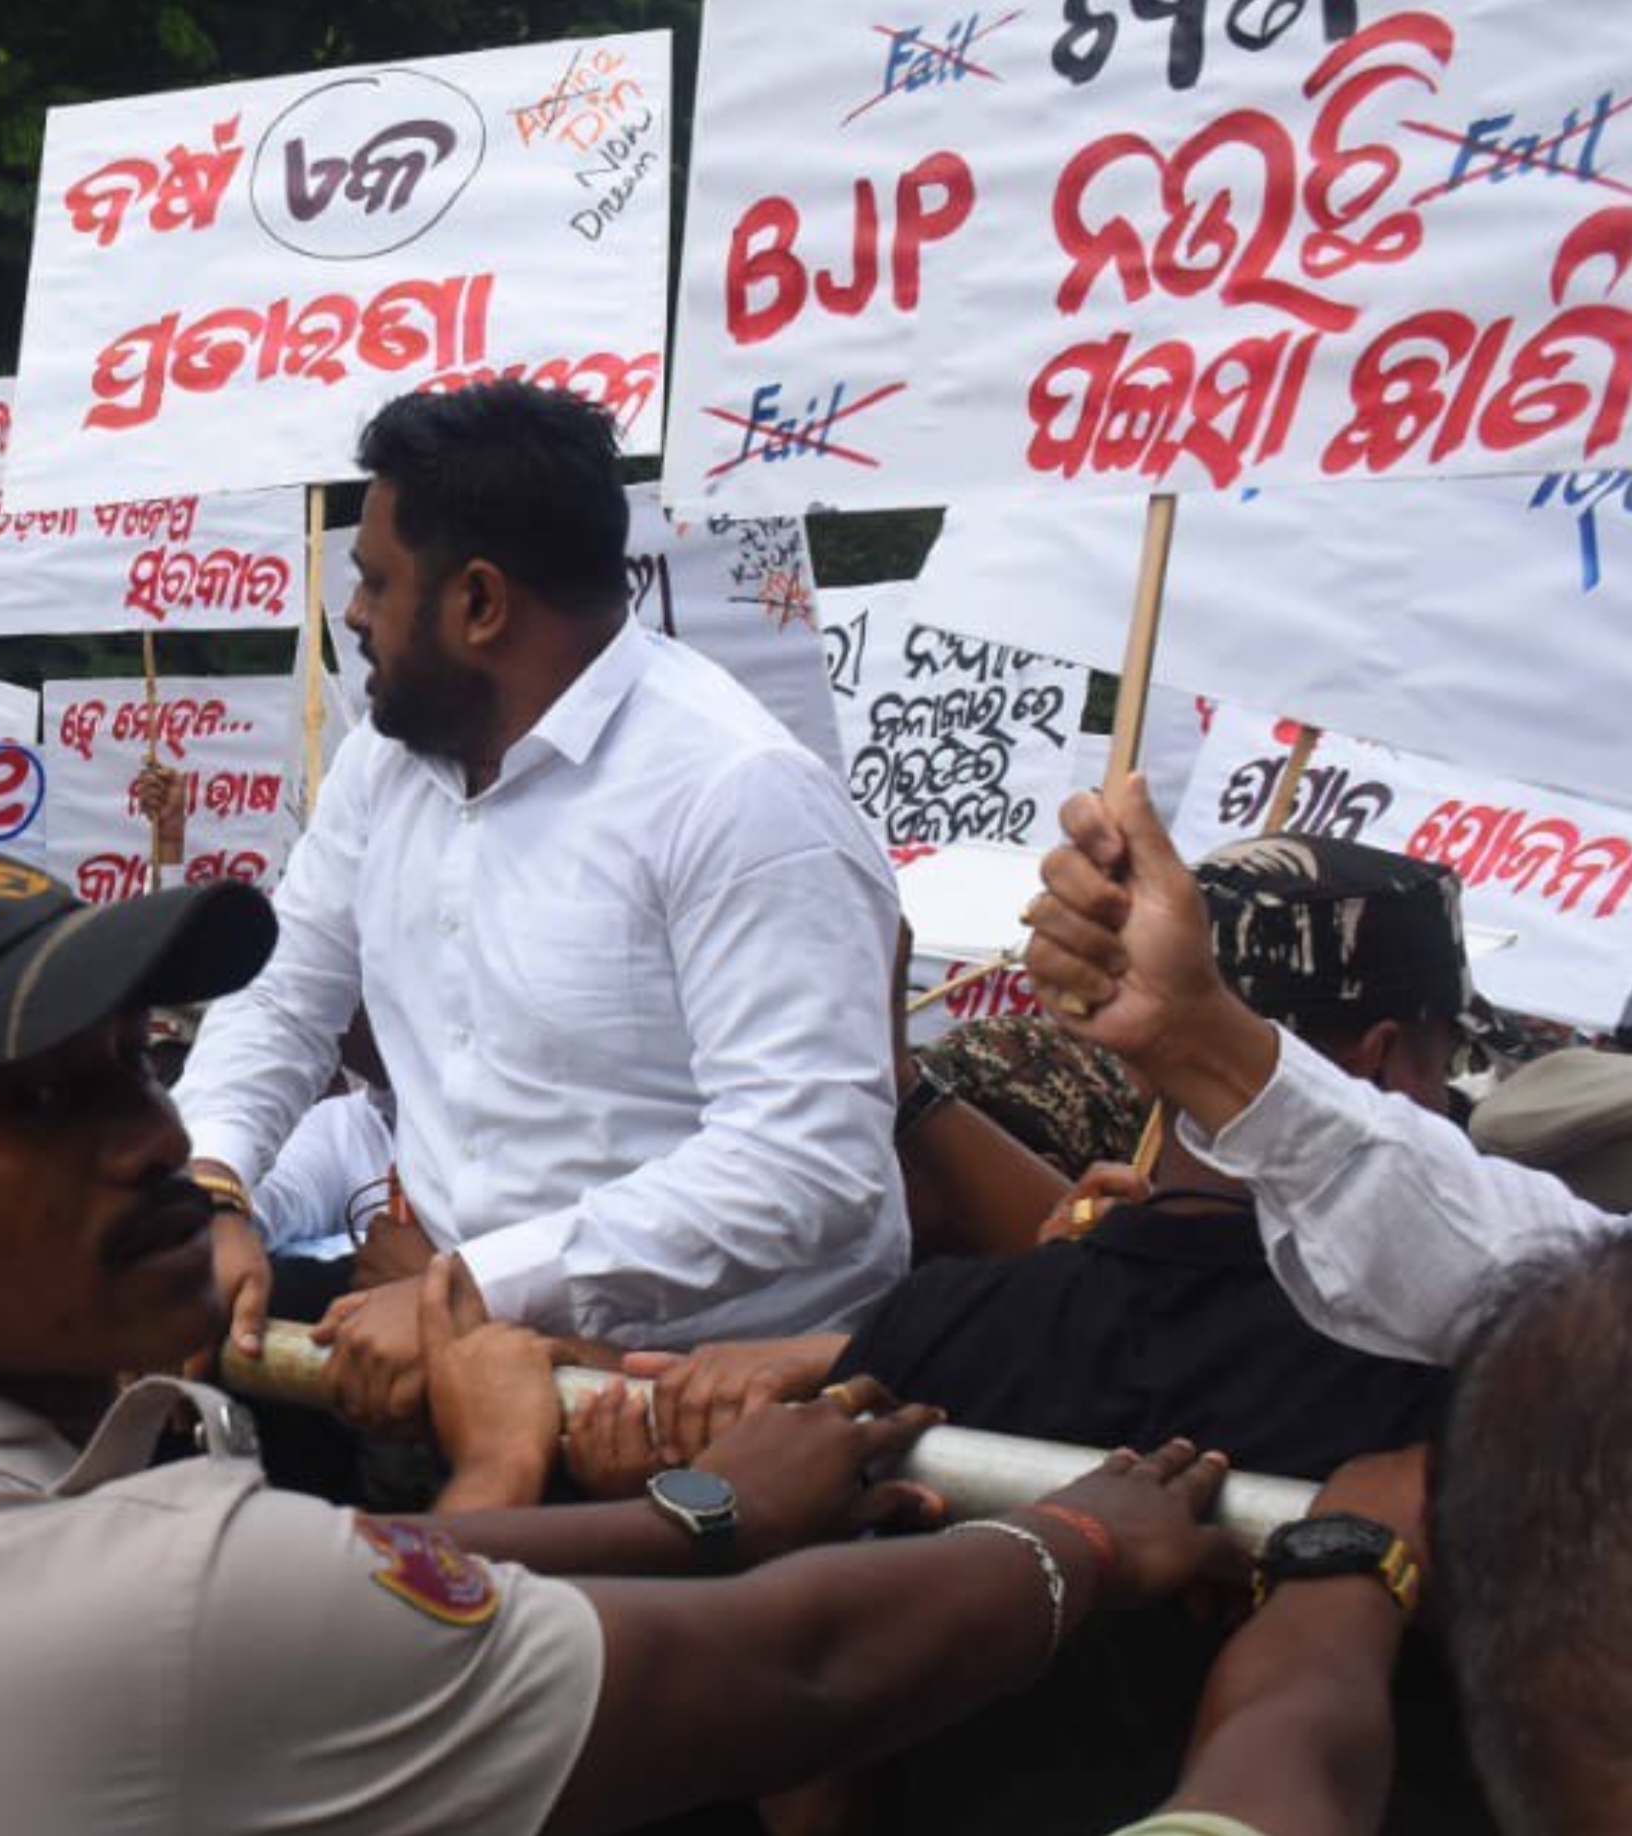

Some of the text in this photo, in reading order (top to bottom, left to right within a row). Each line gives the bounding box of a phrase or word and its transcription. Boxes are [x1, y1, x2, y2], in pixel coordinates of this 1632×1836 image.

[884, 14, 978, 95] Fail
[1449, 90, 1613, 190] Fail
[726, 150, 976, 345] BJP
[739, 382, 845, 464] Fail
